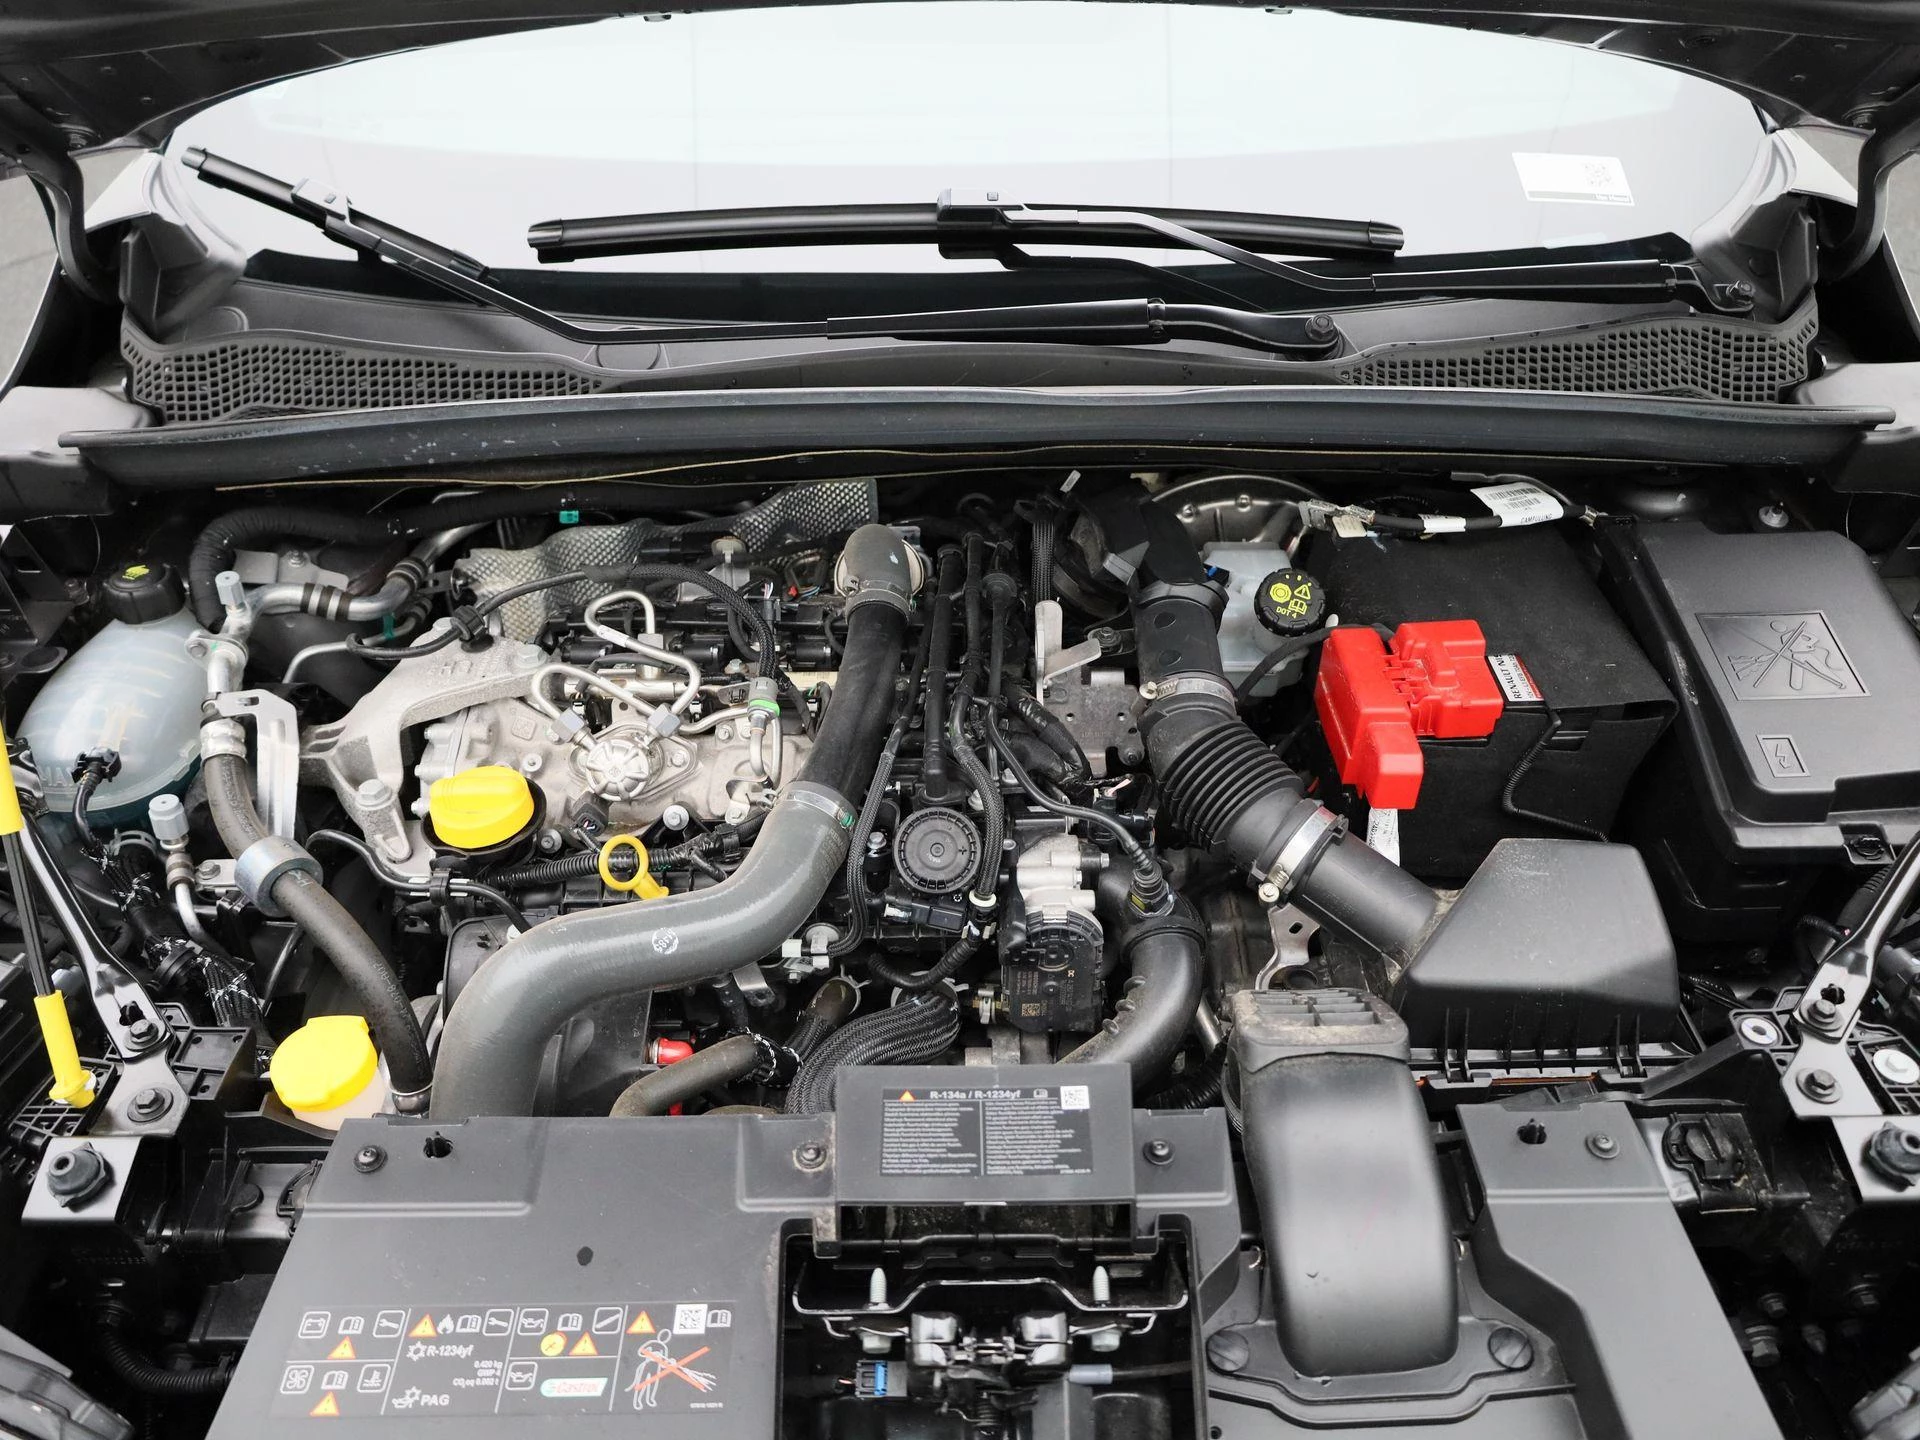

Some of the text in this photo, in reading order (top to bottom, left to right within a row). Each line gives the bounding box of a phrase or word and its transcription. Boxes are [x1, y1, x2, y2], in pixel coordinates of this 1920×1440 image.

[1276, 606, 1291, 617] DOT
[1501, 668, 1522, 699] RENAULT
[929, 1090, 967, 1100] R-134a
[974, 1089, 1022, 1100] R-1234yf
[426, 1344, 475, 1359] R-1234yf
[420, 1393, 450, 1406] PAG
